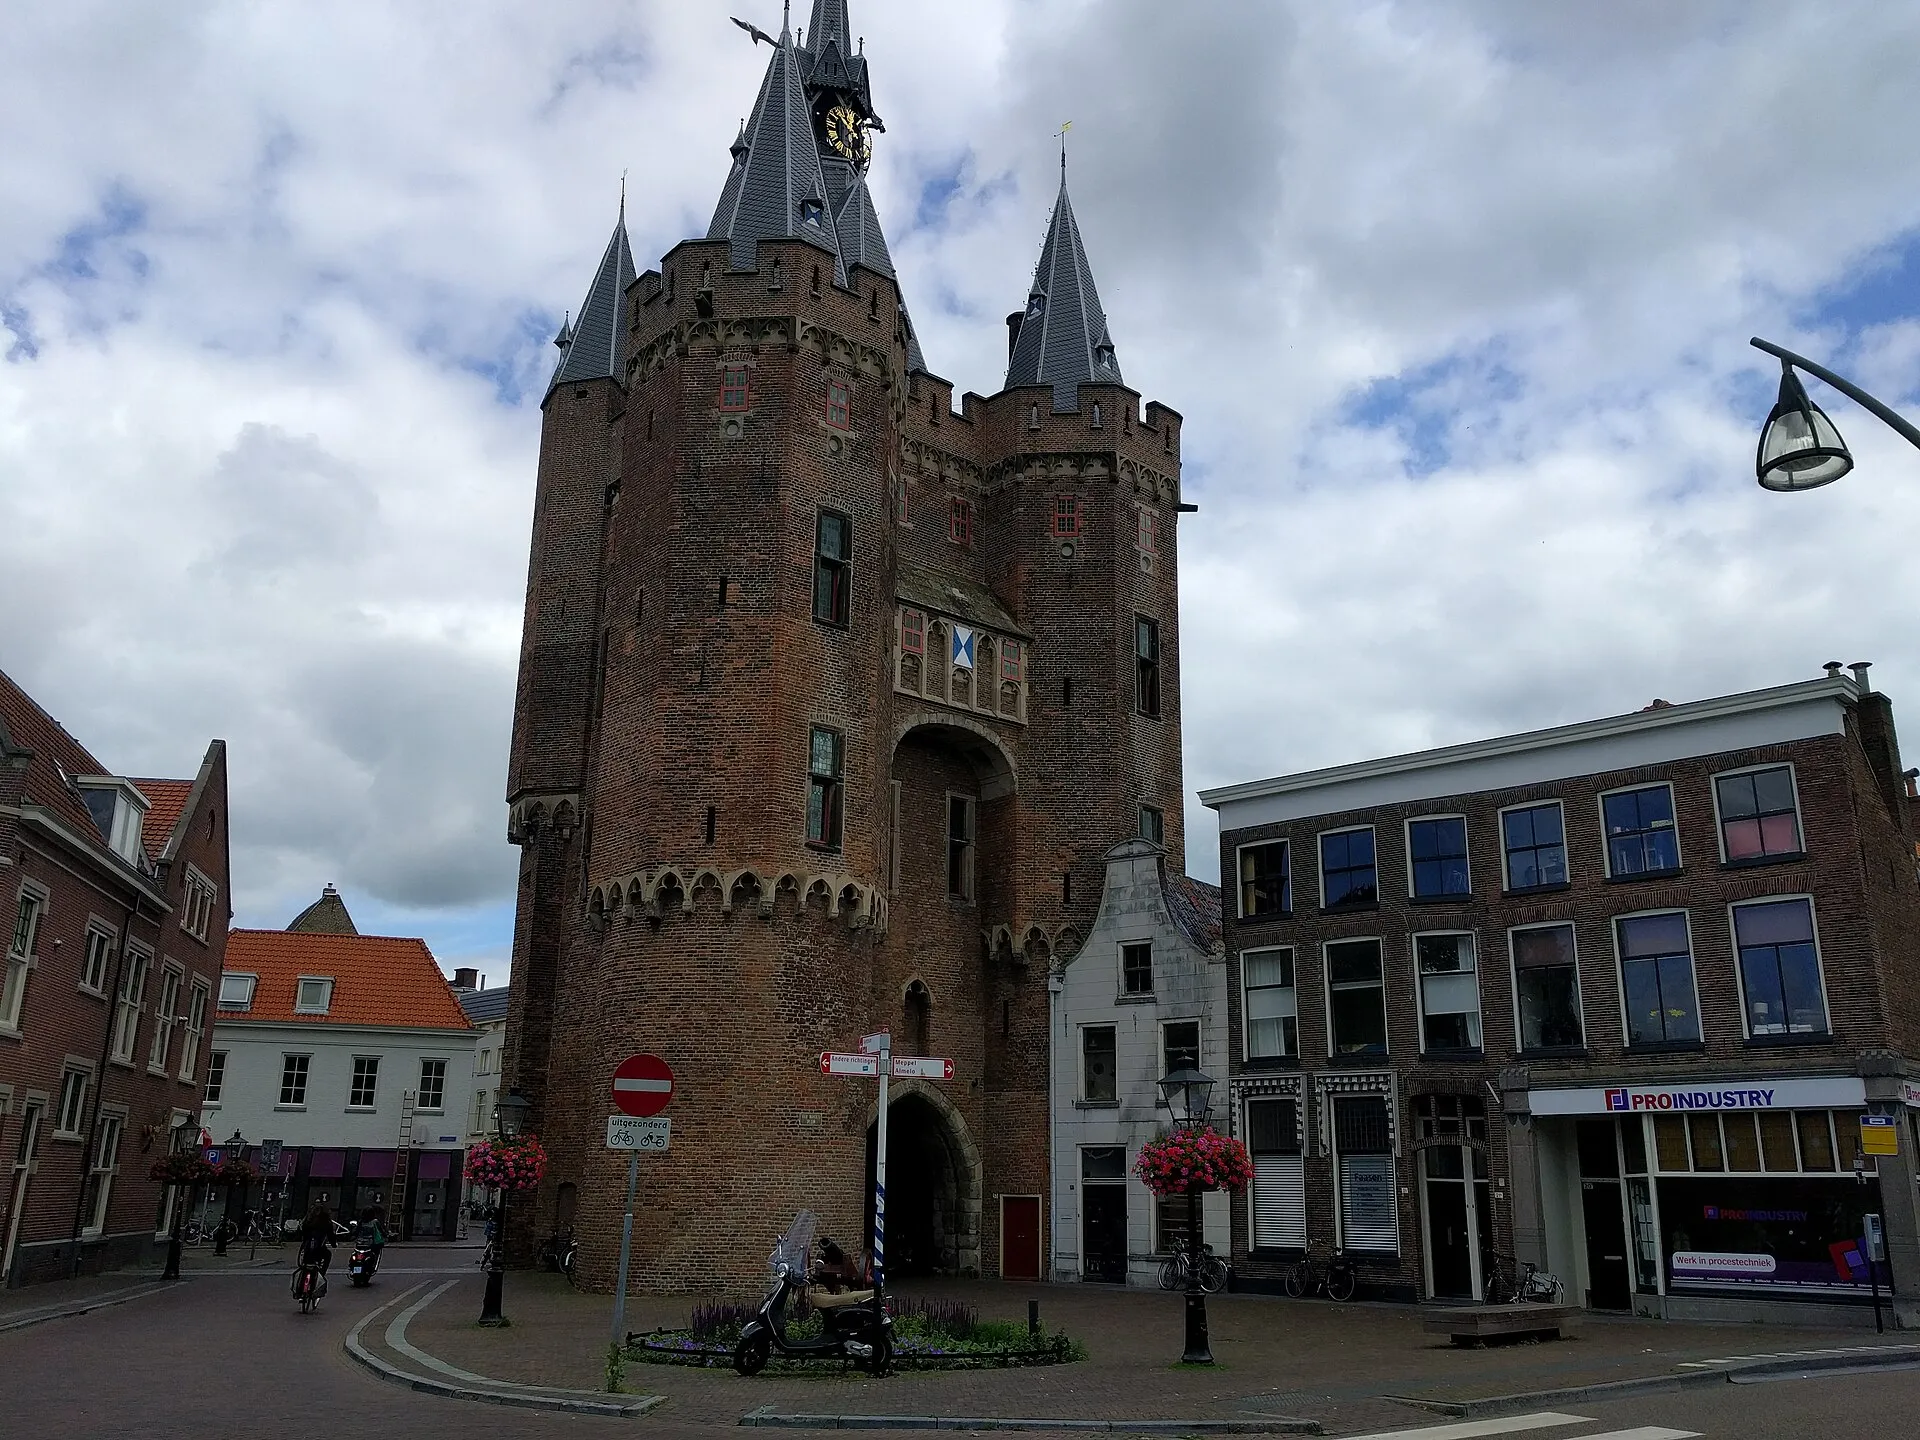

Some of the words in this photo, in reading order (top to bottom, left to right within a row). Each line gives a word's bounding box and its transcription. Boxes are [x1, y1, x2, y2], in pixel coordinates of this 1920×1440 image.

[895, 1059, 917, 1067] Meppel
[895, 1067, 916, 1075] Almelo
[1631, 1089, 1774, 1110] PROINDUSTRY
[611, 1118, 668, 1129] uitgezonderd
[1719, 1207, 1808, 1222] PROINDUSTRY
[1676, 1256, 1697, 1264] Werk
[1698, 1256, 1706, 1265] in
[1708, 1258, 1772, 1267] procestechniek
